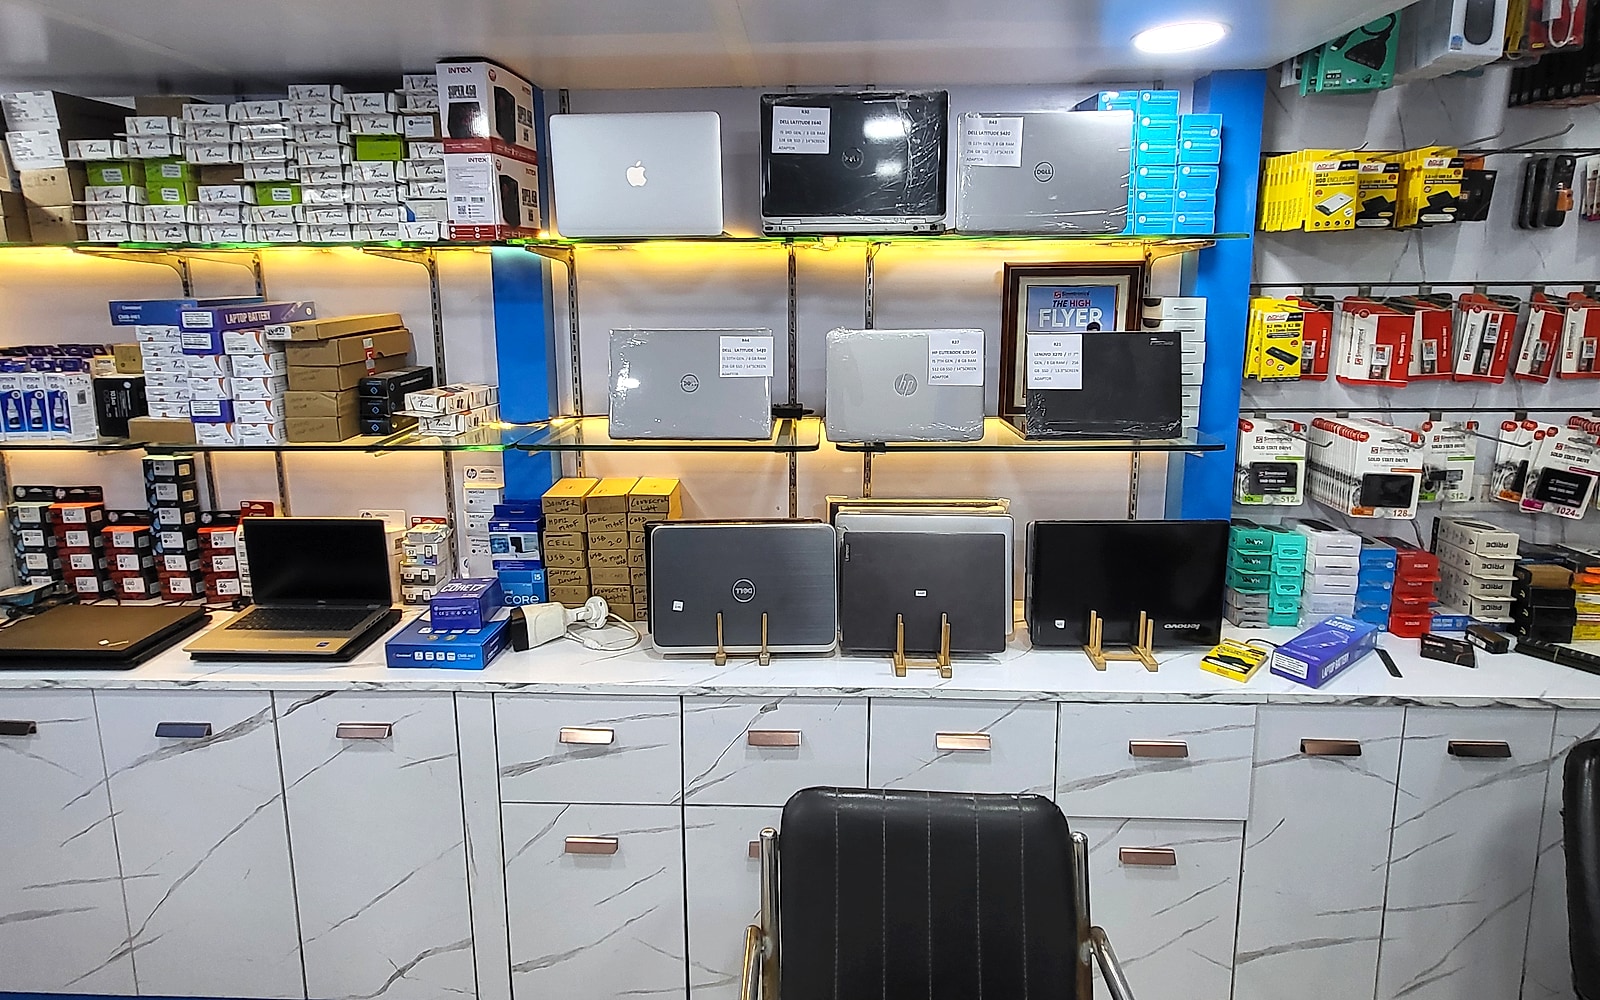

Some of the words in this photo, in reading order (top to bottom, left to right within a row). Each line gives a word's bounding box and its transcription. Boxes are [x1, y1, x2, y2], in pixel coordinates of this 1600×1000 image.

[448, 66, 473, 74] INTEX
[1069, 299, 1091, 307] HIGH
[225, 313, 248, 324] LAPTOP
[248, 311, 271, 322] BATTERY
[1039, 307, 1104, 328] FLYER
[466, 468, 478, 479] hp
[1393, 509, 1408, 517] 128
[1556, 507, 1576, 517] 1024
[591, 535, 606, 543] USB
[1486, 541, 1509, 549] PRIDE
[547, 554, 565, 562] USB
[1321, 662, 1335, 679] LAPTOP
[1335, 652, 1350, 672] BATTERY
